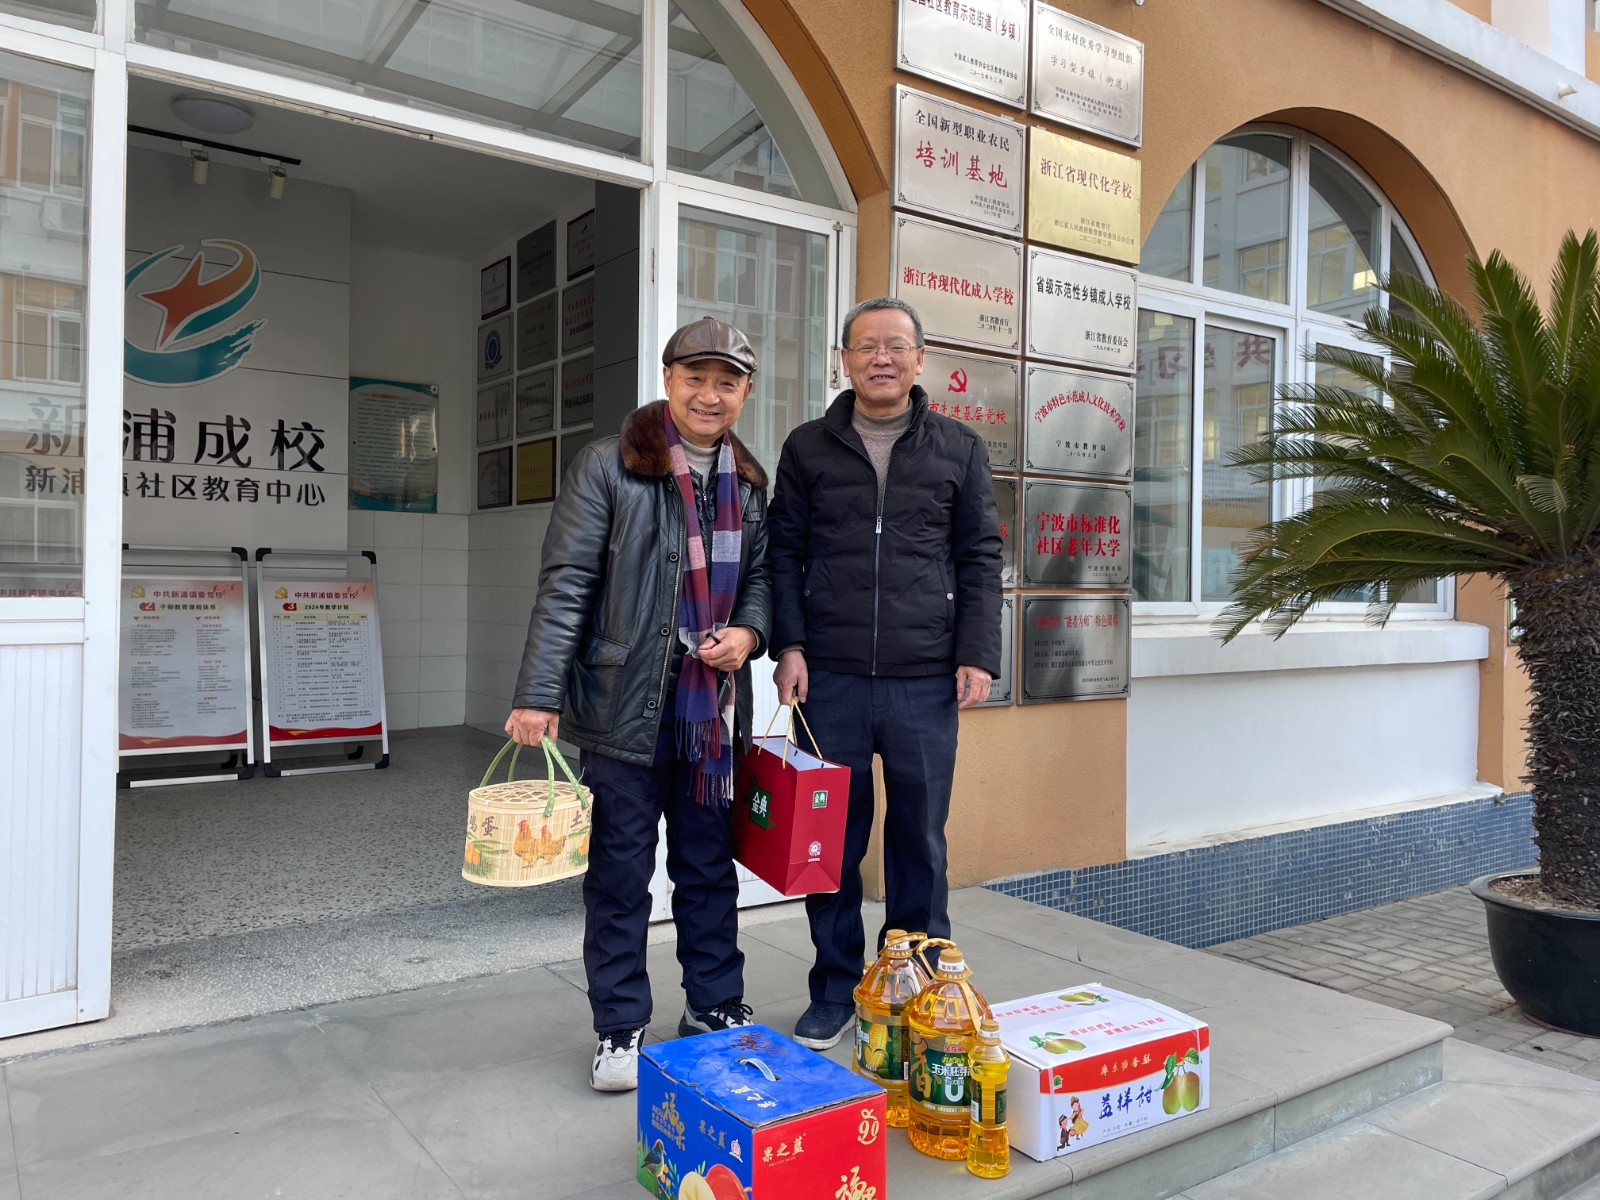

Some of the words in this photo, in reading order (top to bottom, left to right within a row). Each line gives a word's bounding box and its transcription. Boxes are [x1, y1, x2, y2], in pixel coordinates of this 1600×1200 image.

[1047, 23, 1134, 65] 全国农村优秀学习型组织
[914, 109, 1010, 152] 全国新型职业农民
[915, 141, 1008, 188] 培训基地
[1040, 157, 1132, 199] 浙江省现代化学校
[1080, 217, 1111, 231] 浙江省教育厅
[903, 266, 1014, 306] 浙江省现代化成人学校
[1036, 275, 1132, 311] 省级示范性乡镇成人学校
[979, 314, 1009, 326] 浙江省教育厅
[1084, 329, 1128, 347] 浙江省教育委员会
[1034, 390, 1127, 432] 宁波市特色示范成人文化技术学校
[25, 397, 326, 472] 新浦成校
[1056, 439, 1106, 452] 宁波市教育局
[25, 465, 326, 507] 新浦社区教育中心
[1036, 511, 1121, 536] 宁波市标准化
[1036, 536, 1121, 558] 社区老年大学
[153, 590, 223, 599] 中共新浦镇委党校
[294, 591, 357, 599] 中共新浦镇委党校
[751, 791, 767, 818] 金典
[814, 792, 825, 803] 金典
[944, 1045, 964, 1053] 金龙鱼
[932, 1063, 970, 1077] 玉米胚芽
[762, 1136, 805, 1163] 果之蓝
